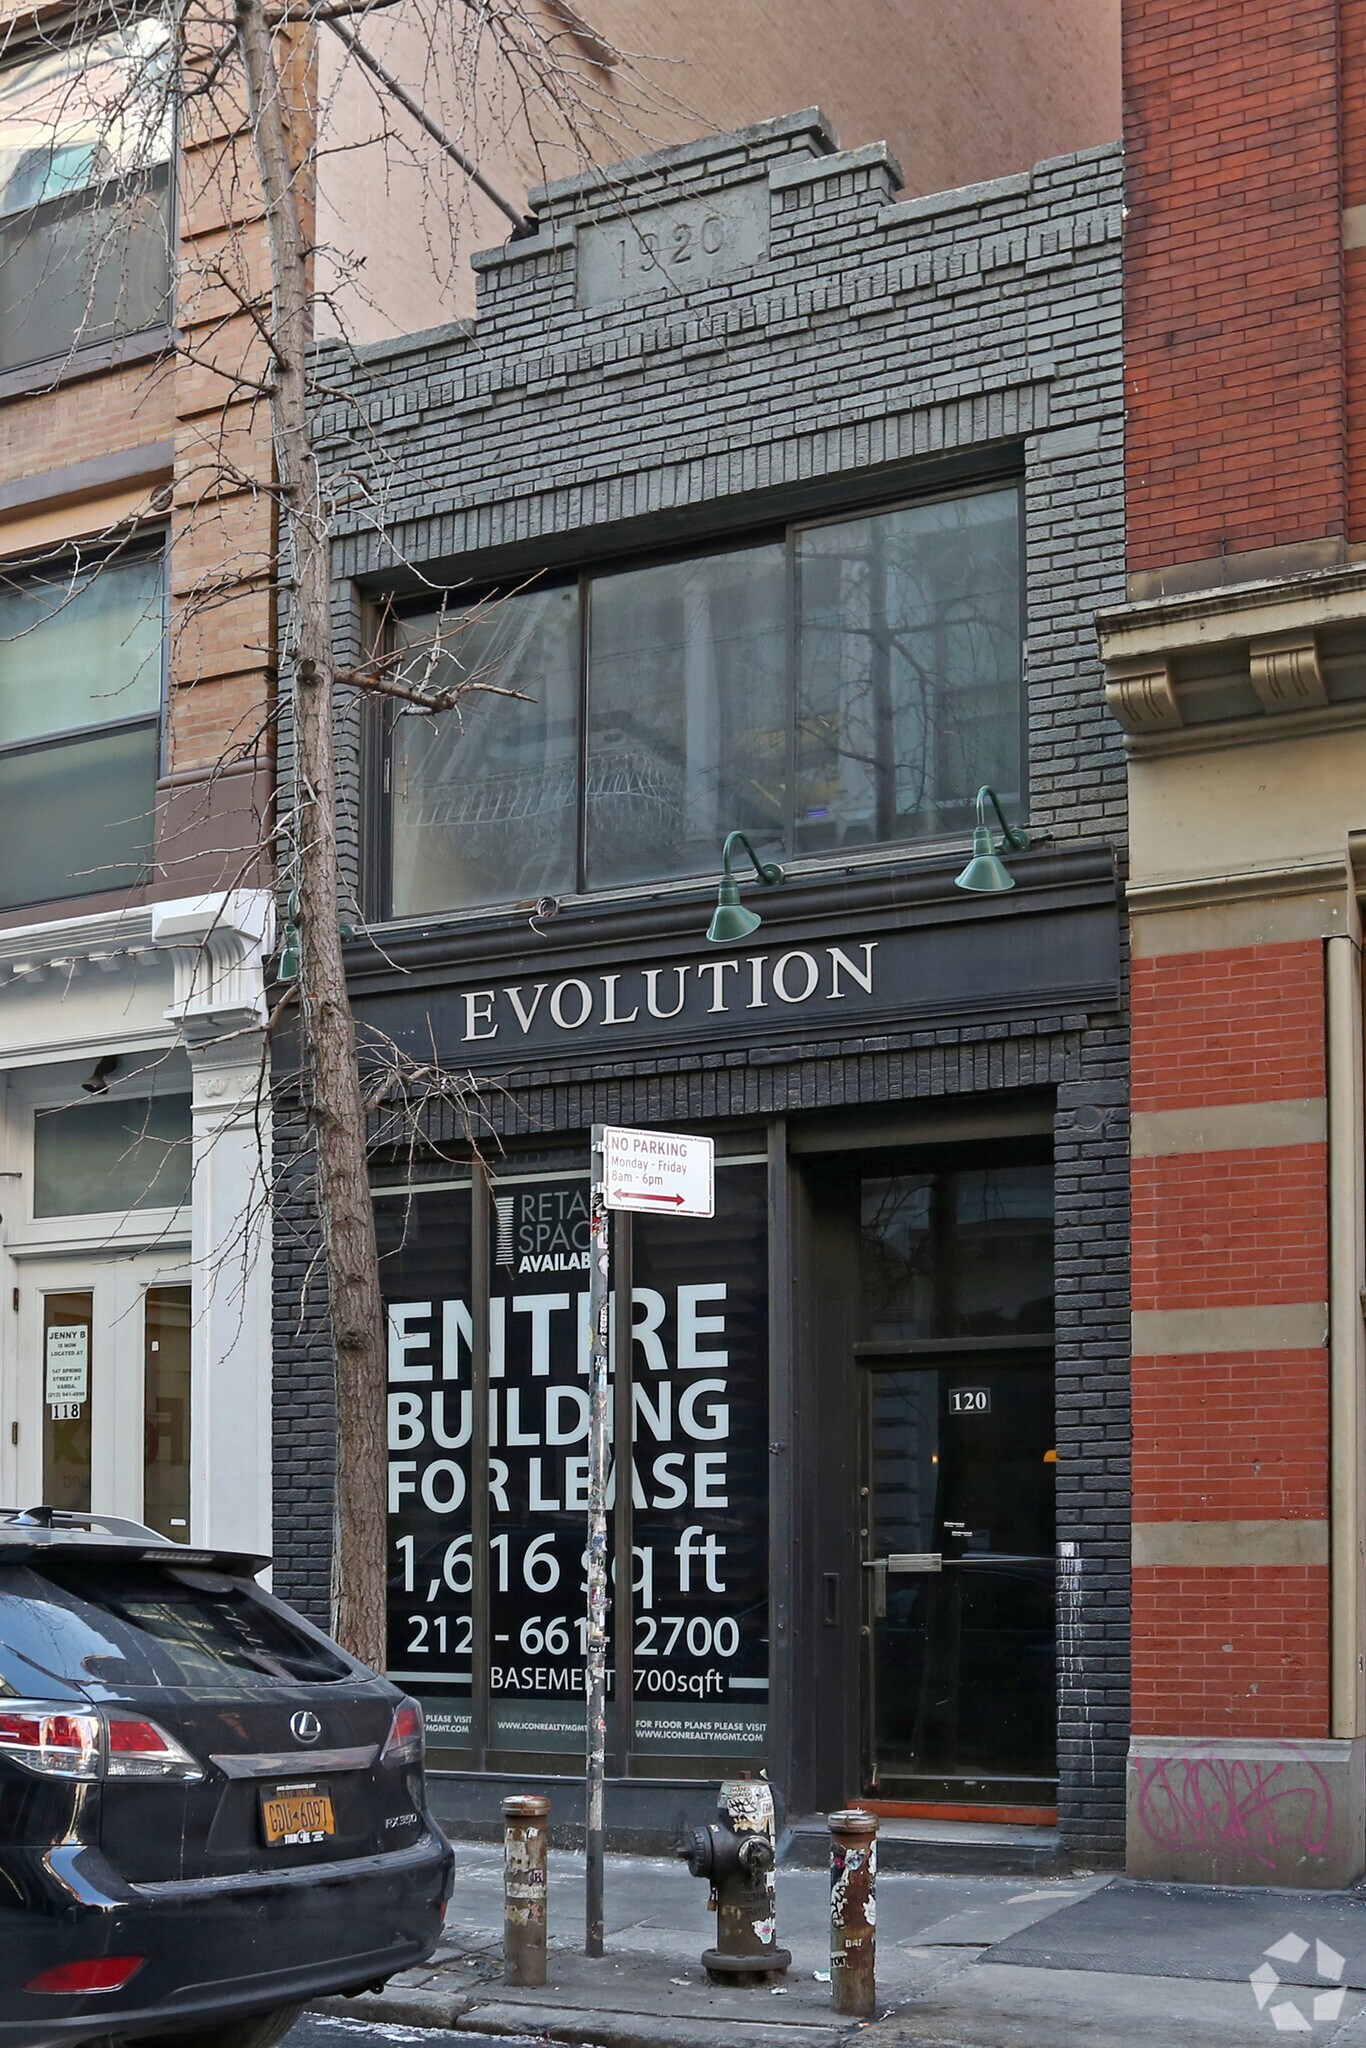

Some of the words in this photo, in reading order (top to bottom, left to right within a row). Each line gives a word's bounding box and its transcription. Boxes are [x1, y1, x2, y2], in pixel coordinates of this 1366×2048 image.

[616, 216, 724, 279] 1920
[460, 942, 879, 1042] EVOLUTION
[611, 1136, 629, 1151] NO
[633, 1139, 688, 1158] PARKING
[611, 1155, 649, 1172] Monday
[658, 1160, 688, 1176] Friday
[611, 1170, 633, 1183] 8am
[642, 1173, 664, 1187] 6pm
[521, 1190, 589, 1222] RETA
[518, 1220, 592, 1254] SPAC
[518, 1251, 593, 1273] AVAILAB
[49, 1331, 77, 1340] JENNY
[80, 1330, 86, 1339] B
[387, 1282, 729, 1382] ENTIRE
[54, 1404, 79, 1418] 118
[953, 1391, 987, 1410] 120
[387, 1458, 511, 1513] FOR
[395, 1533, 560, 1602] 1,616
[674, 1526, 727, 1593] ft
[407, 1615, 473, 1653] 212
[519, 1615, 588, 1655] 661
[633, 1616, 740, 1657] 2700
[490, 1667, 615, 1691] BASEMET
[633, 1668, 724, 1698] 700sqft
[424, 1724, 470, 1733] MGMT.COM
[426, 1714, 452, 1723] PLEASE
[453, 1715, 472, 1724] VISIT
[497, 1722, 588, 1732] WWW.ICONREALTYMGMT
[635, 1719, 652, 1729] FOR
[654, 1720, 682, 1729] FLOOR
[684, 1721, 712, 1730] PLANS
[714, 1721, 743, 1731] PLEASE
[745, 1722, 767, 1732] VISIT
[635, 1730, 763, 1742] WWW.ICONREALTYMGMT.COM
